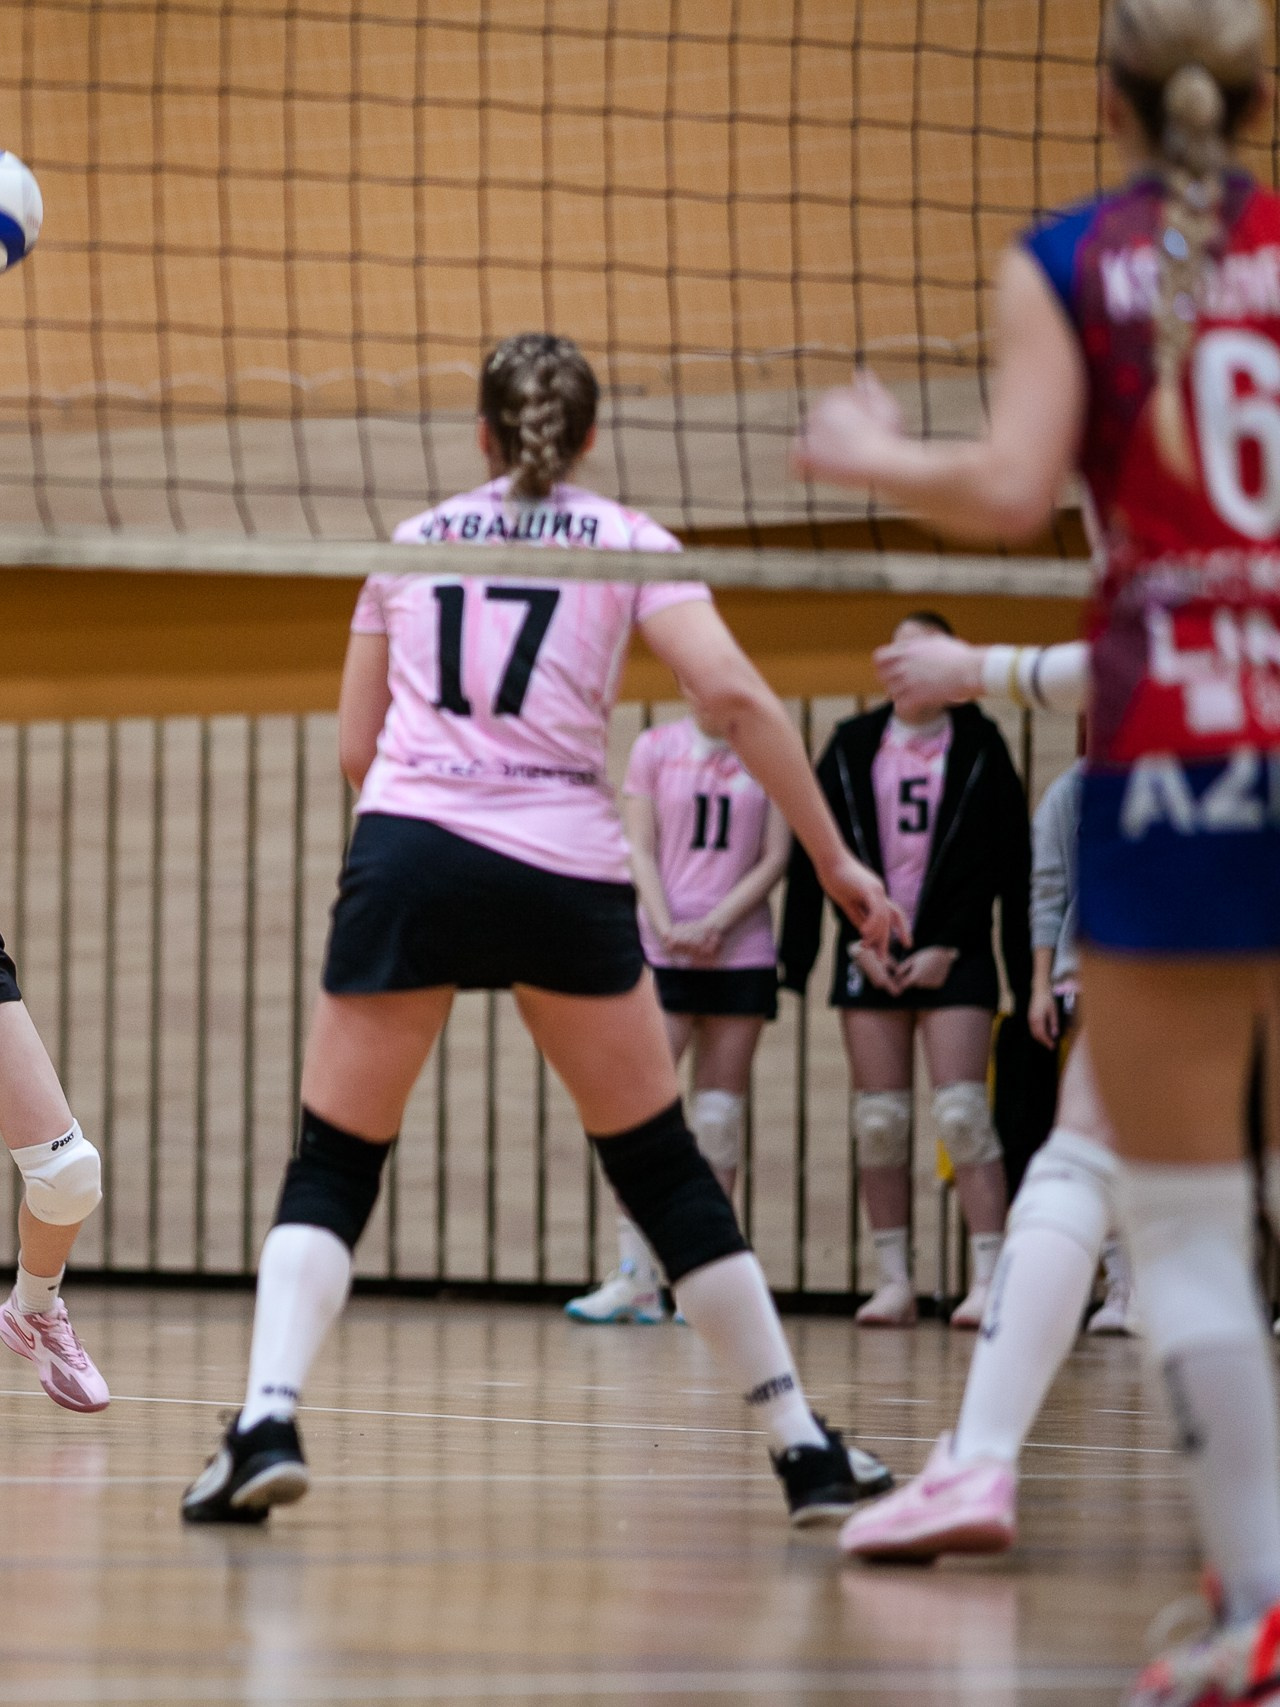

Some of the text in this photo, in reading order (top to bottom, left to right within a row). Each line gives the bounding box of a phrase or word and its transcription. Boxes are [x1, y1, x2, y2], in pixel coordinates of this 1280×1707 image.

[1193, 328, 1280, 542] 6
[432, 584, 561, 716] 17
[691, 793, 730, 849] 11
[899, 777, 928, 833] 5
